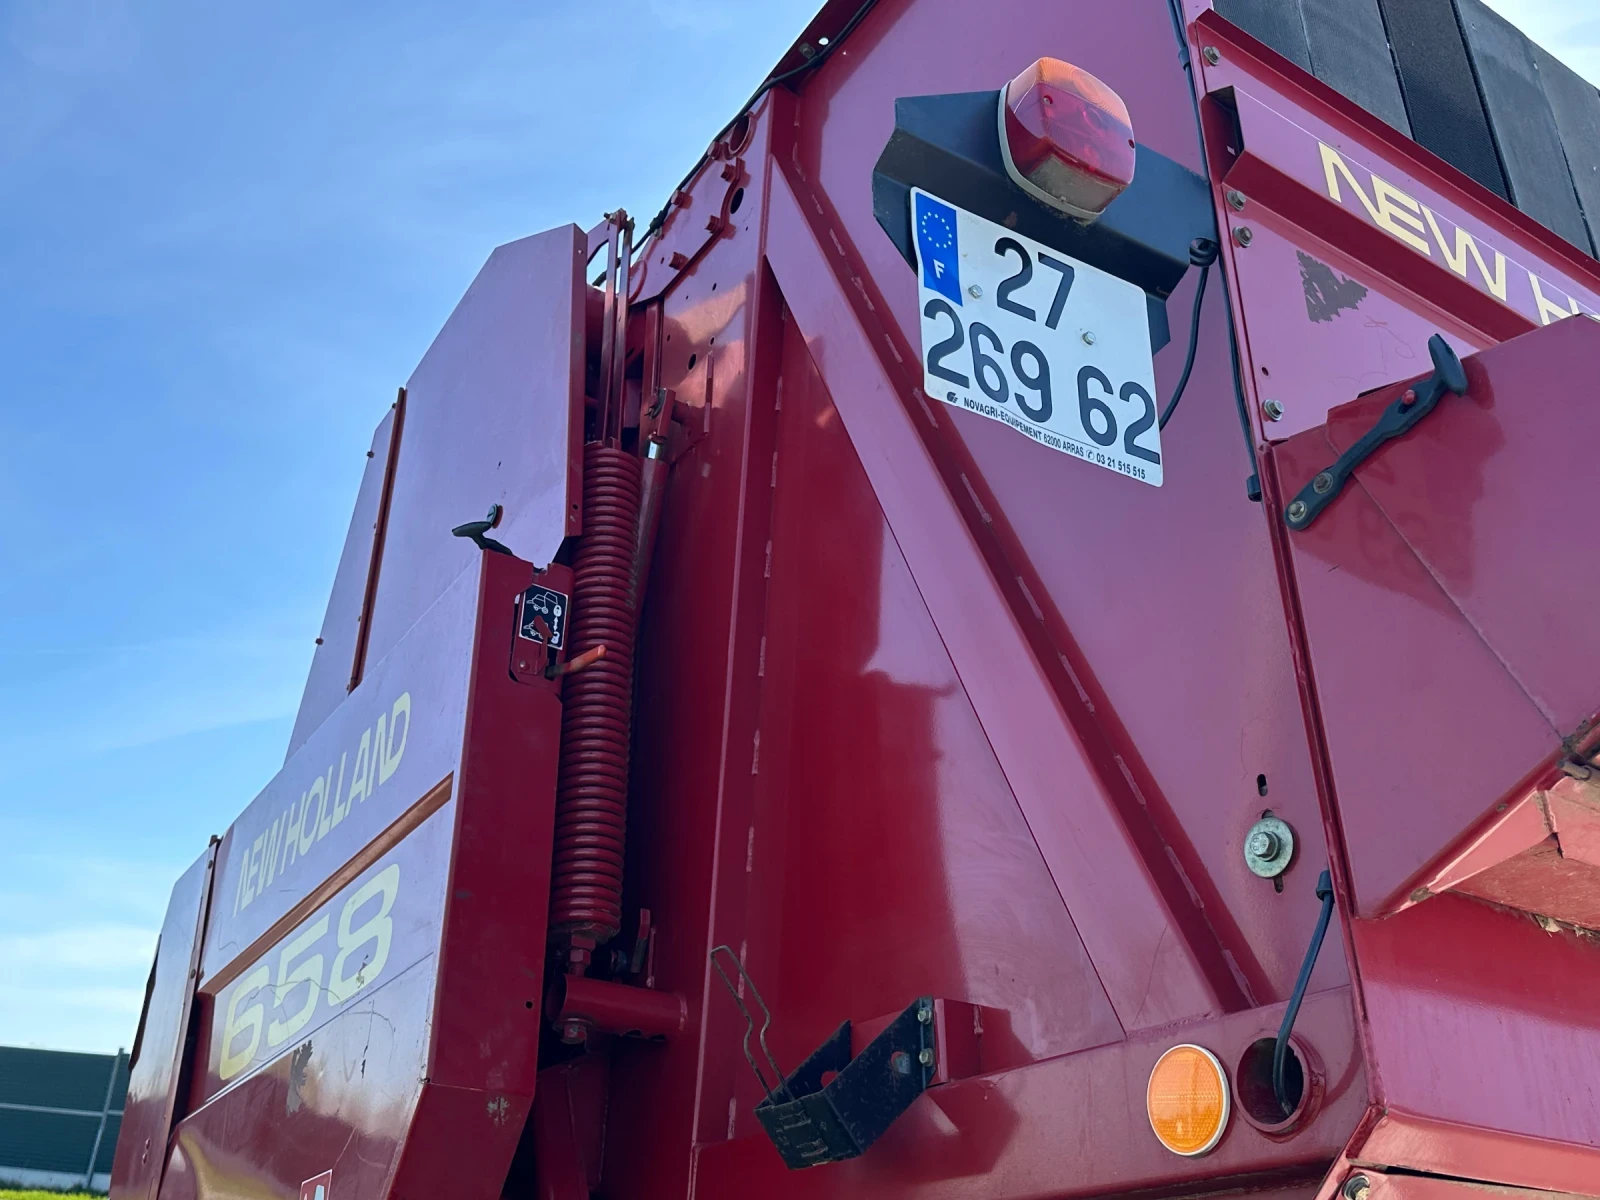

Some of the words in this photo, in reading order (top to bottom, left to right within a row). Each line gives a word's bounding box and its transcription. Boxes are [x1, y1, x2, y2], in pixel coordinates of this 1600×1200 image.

[933, 259, 945, 279] F
[994, 237, 1075, 330] 27
[1318, 141, 1507, 302] NEW
[923, 298, 1053, 423] 269
[1077, 365, 1161, 465] 62
[964, 397, 1042, 440] NOVAGRI-EQUIPEMENT
[1043, 433, 1061, 449] 62000
[1062, 440, 1084, 457] ARRAS
[1096, 452, 1106, 465] 03
[1107, 456, 1116, 469] 21
[1118, 460, 1131, 474] 515
[1132, 466, 1146, 480] 515
[233, 810, 287, 918] NEW
[280, 692, 411, 875] HOLLAND
[219, 863, 400, 1080] 658
